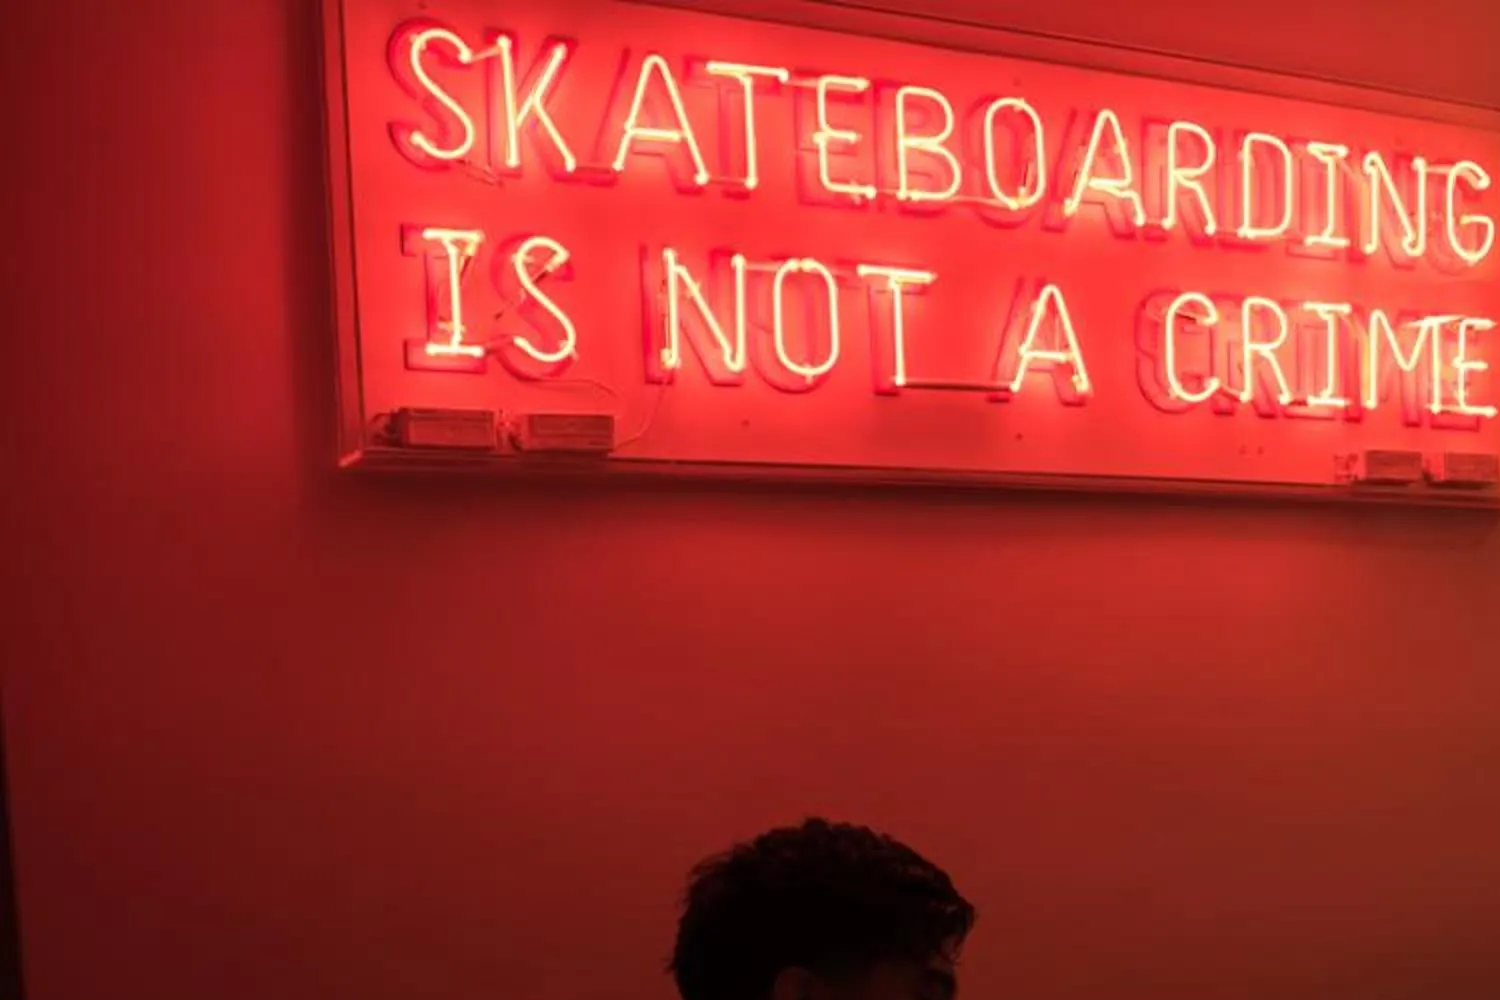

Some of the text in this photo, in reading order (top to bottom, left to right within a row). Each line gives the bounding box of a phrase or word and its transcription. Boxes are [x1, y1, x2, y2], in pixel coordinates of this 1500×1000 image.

[409, 28, 1496, 264] SKATEBOARDING
[422, 228, 1499, 417] IS NOT A CRIME
